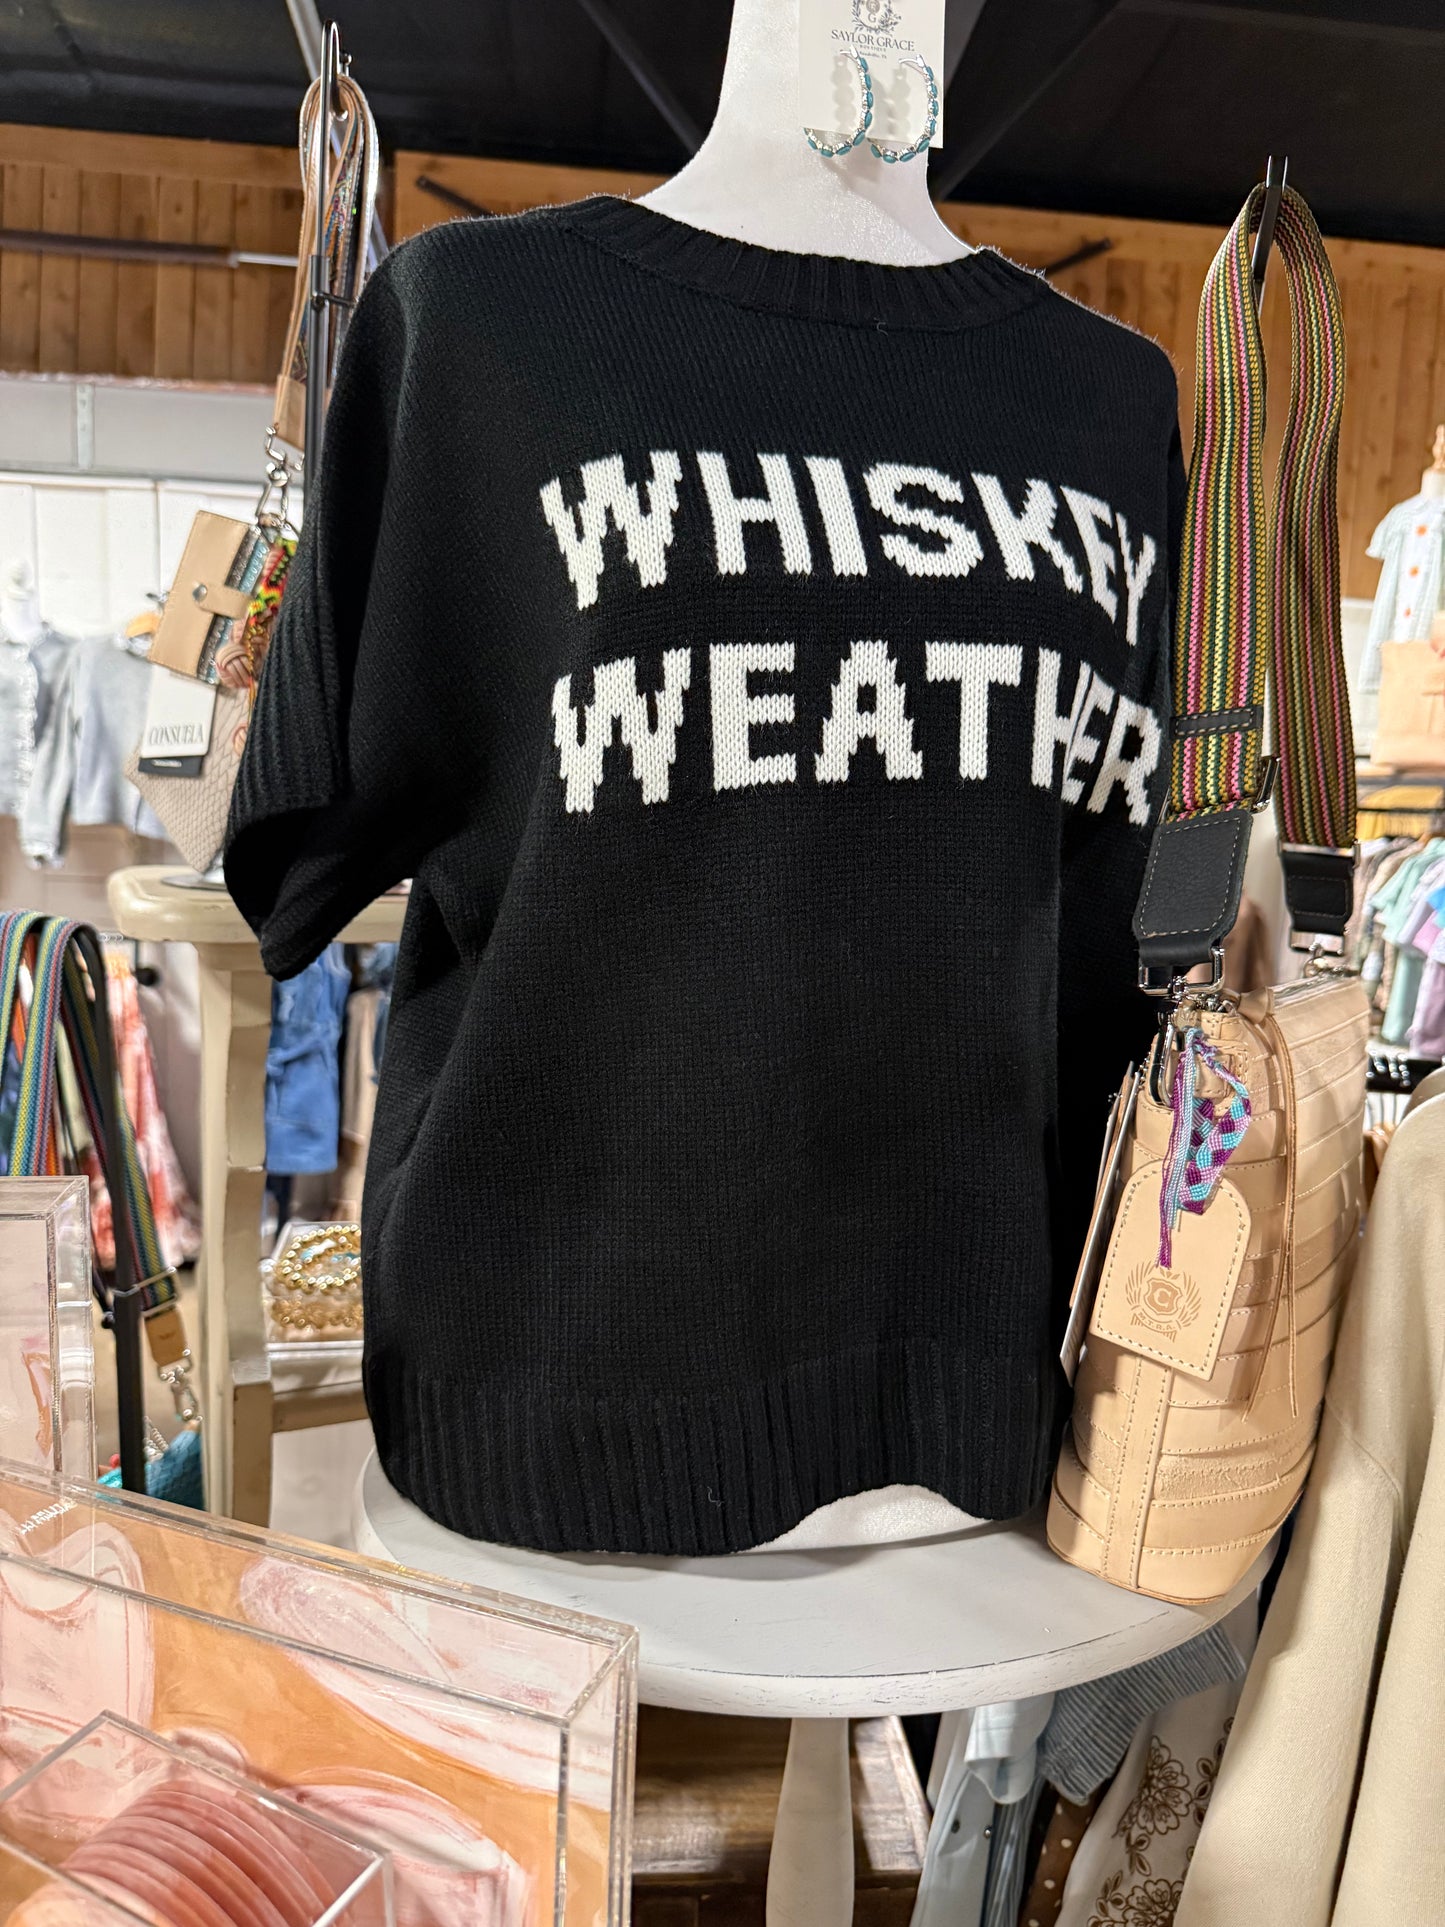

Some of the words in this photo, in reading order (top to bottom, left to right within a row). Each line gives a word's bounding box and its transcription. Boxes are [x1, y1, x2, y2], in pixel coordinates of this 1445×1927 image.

[831, 29, 875, 46] SAYLOR
[876, 36, 915, 52] GRACE
[540, 451, 1156, 645] WHISKEY
[149, 723, 204, 746] CONSUELA
[551, 640, 1163, 826] WEATHER
